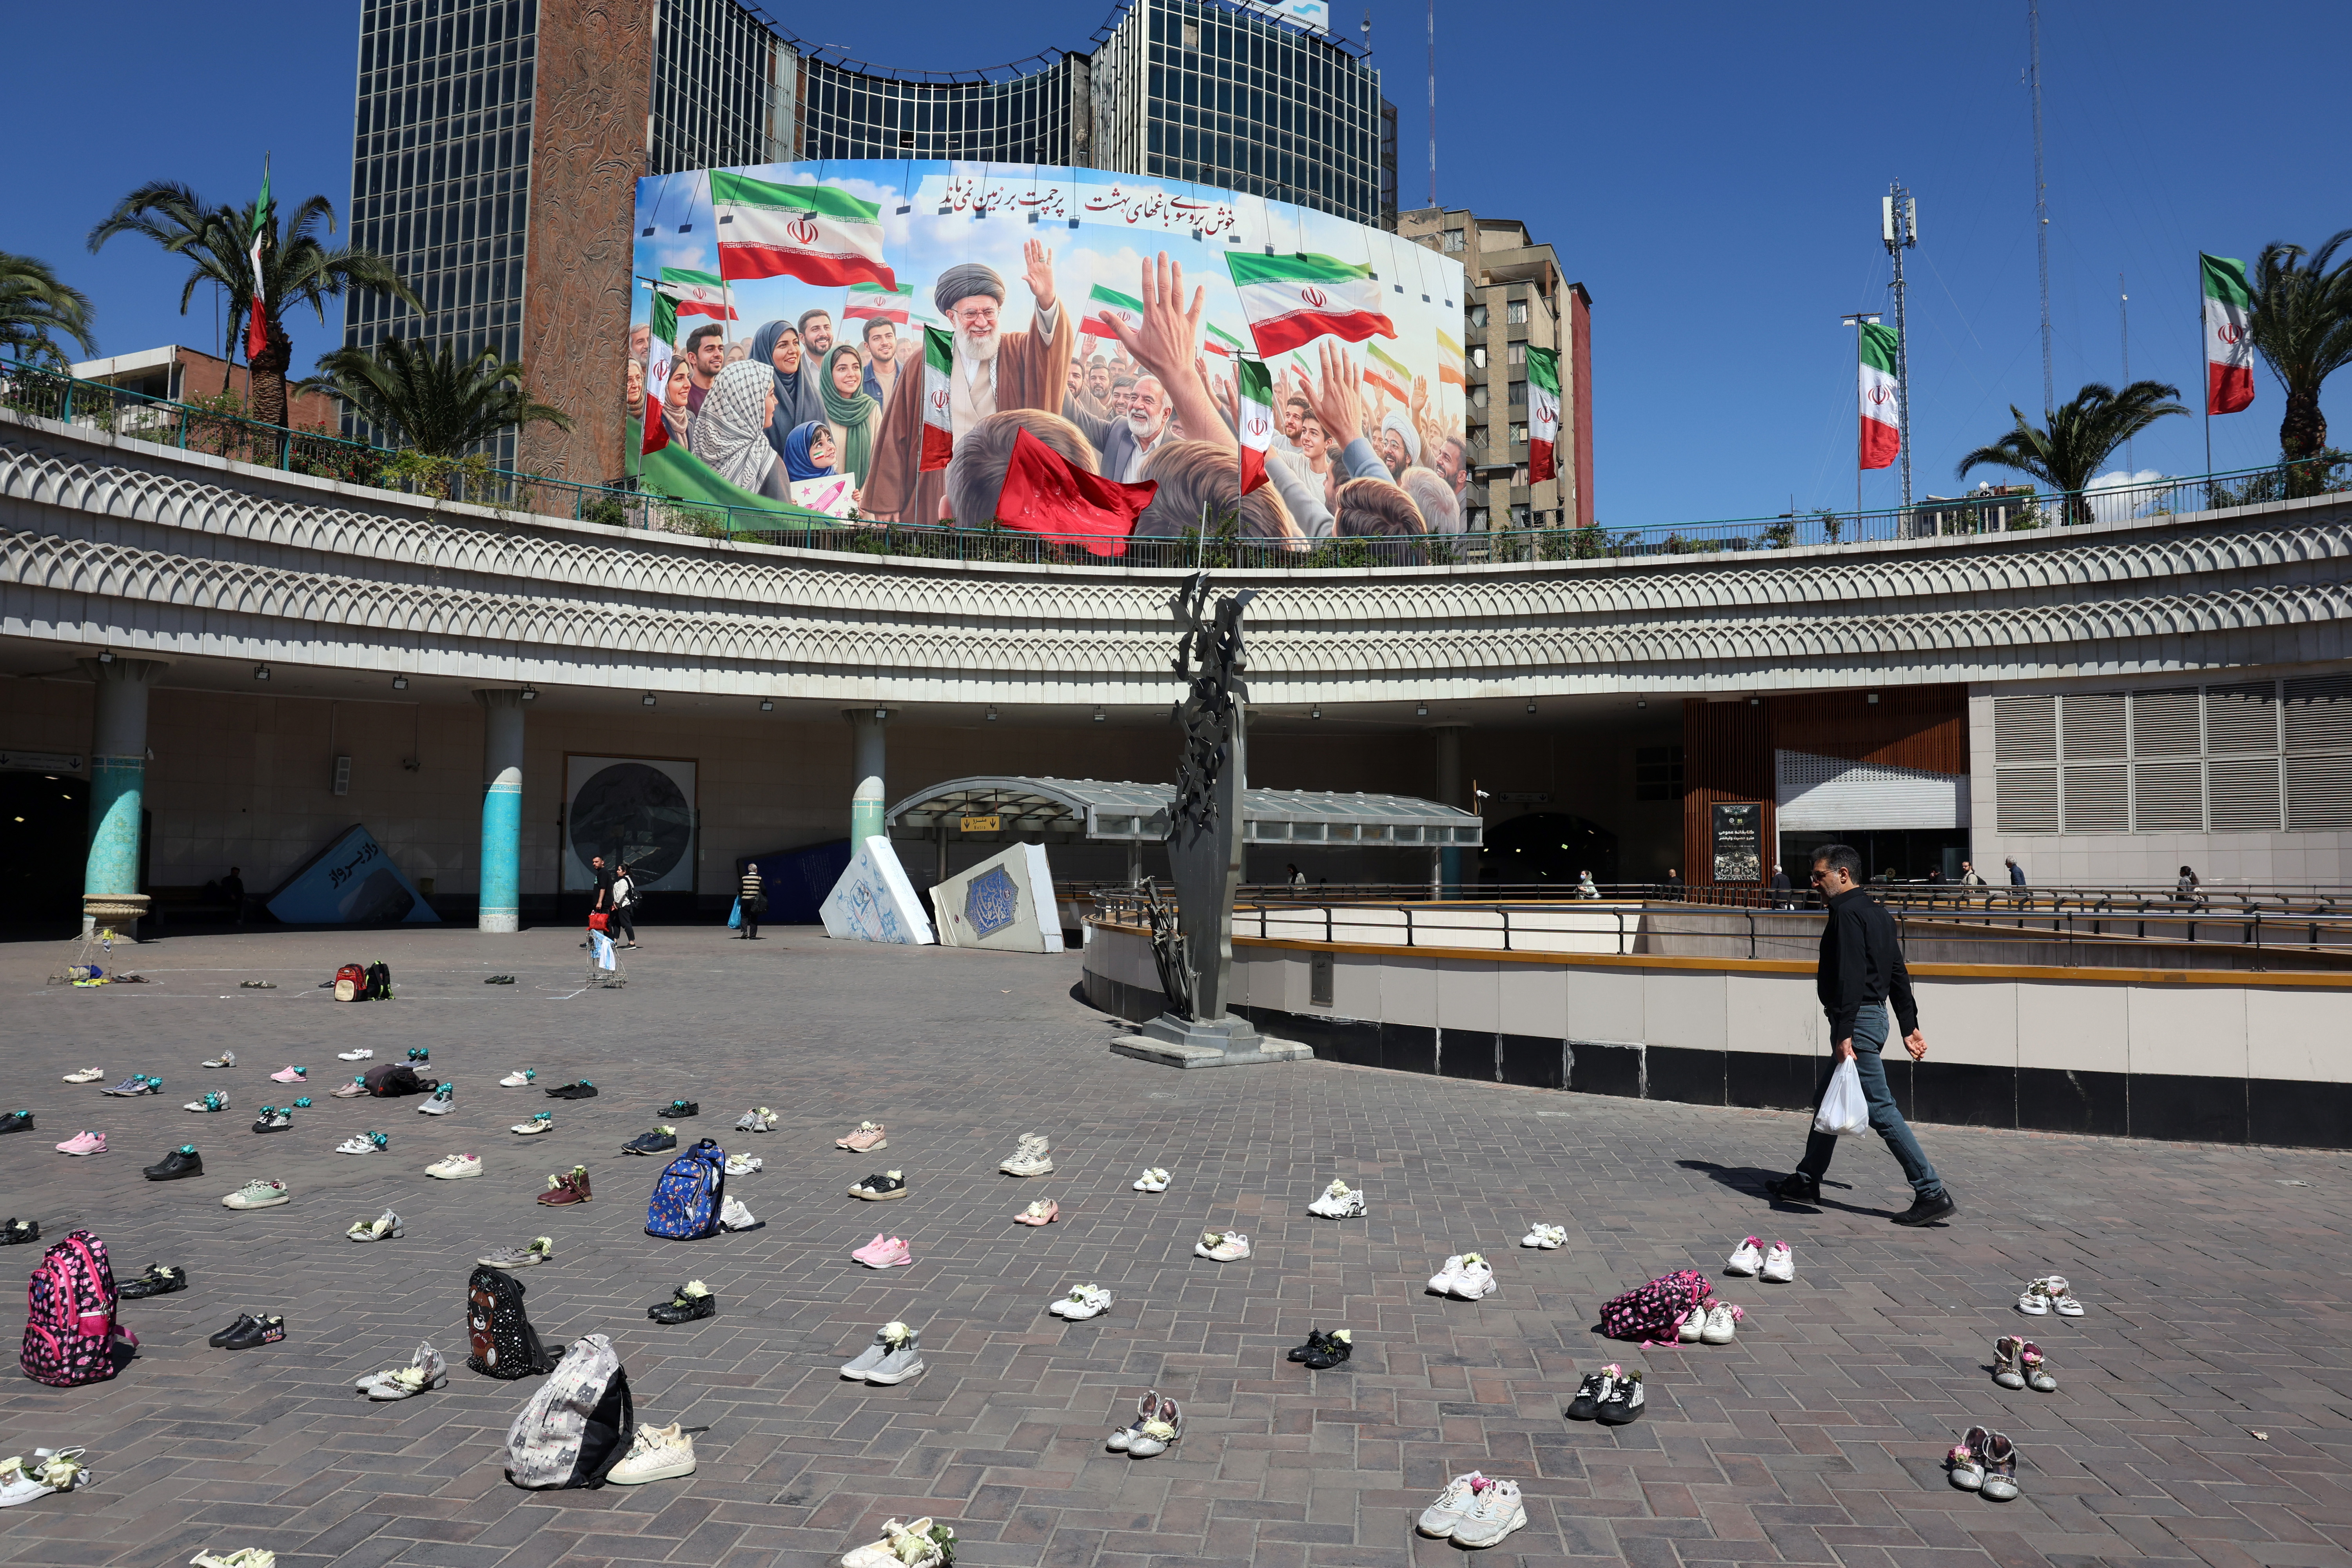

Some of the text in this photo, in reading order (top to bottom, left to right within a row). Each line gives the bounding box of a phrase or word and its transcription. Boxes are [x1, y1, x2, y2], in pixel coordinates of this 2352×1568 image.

[973, 186, 1004, 211] زمین
[1004, 193, 1016, 211] بر
[1018, 188, 1064, 218] پرچمت
[1085, 187, 1131, 213] بهشت
[1205, 207, 1235, 236] خوش
[328, 841, 379, 890] راز پرواز
